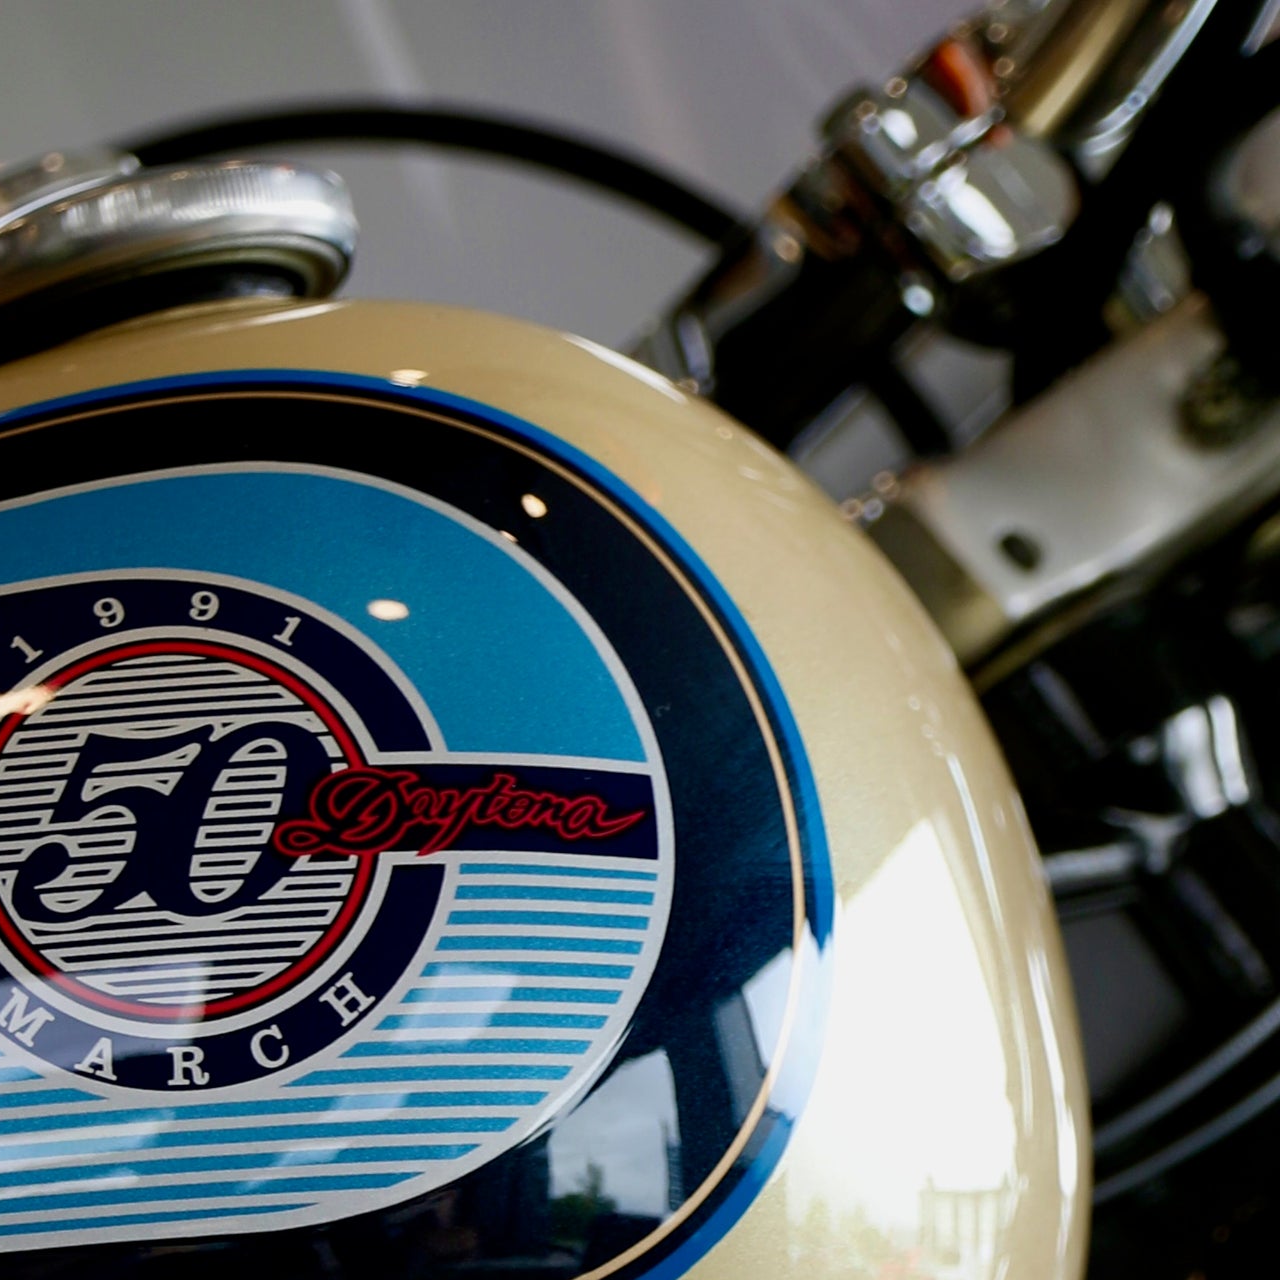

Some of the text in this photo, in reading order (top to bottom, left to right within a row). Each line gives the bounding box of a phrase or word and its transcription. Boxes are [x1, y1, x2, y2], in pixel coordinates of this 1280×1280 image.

[10, 590, 303, 664] 1991
[10, 722, 338, 930] 50
[274, 767, 646, 857] Daytona
